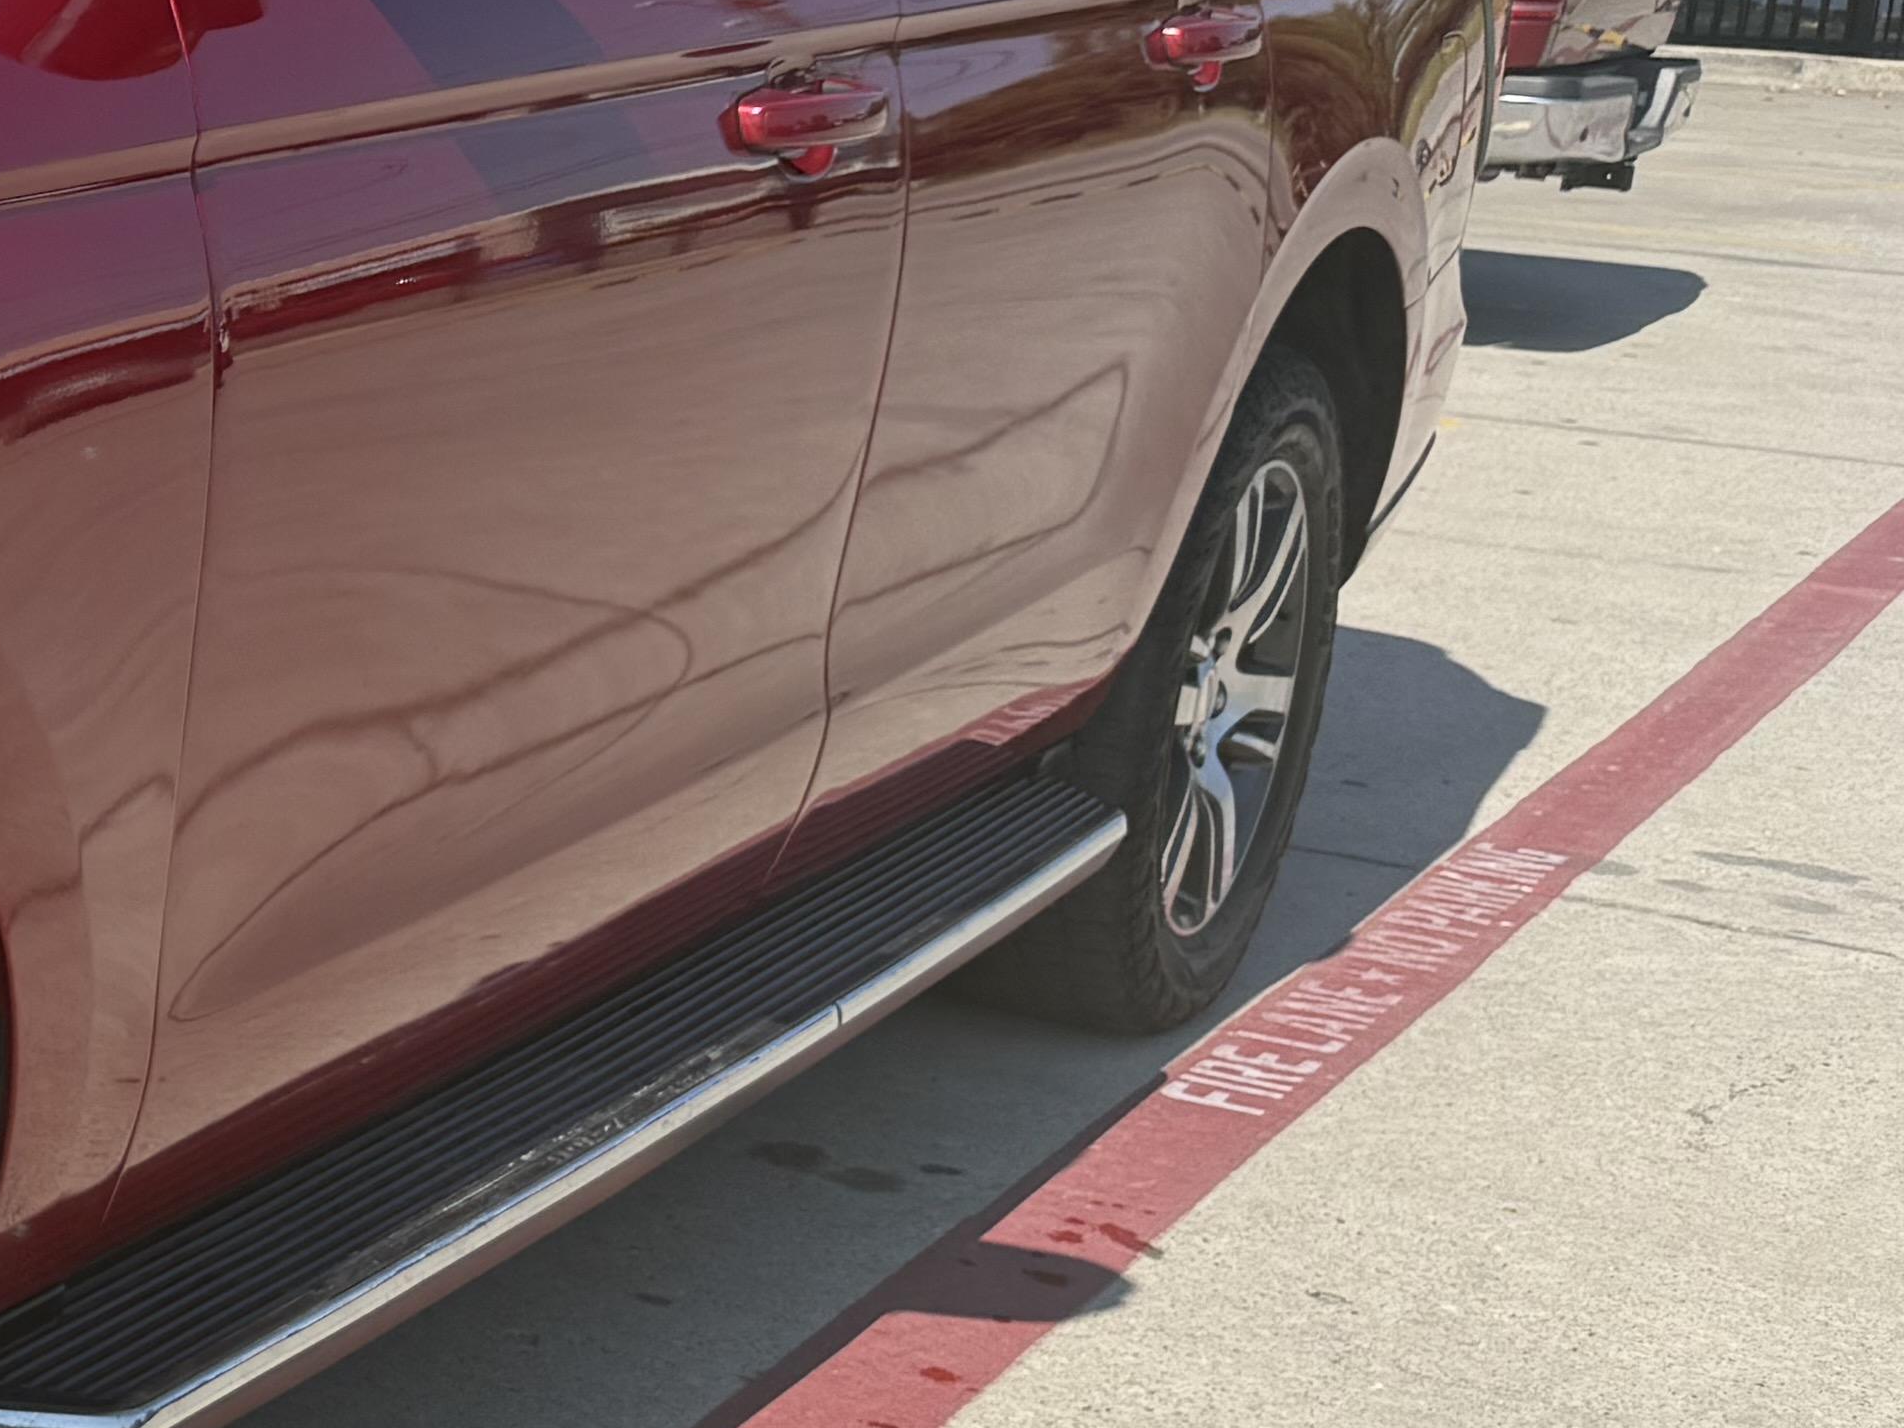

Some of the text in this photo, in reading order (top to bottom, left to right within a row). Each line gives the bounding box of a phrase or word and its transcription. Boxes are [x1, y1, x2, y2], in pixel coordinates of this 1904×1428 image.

[1160, 842, 1570, 1117] FIRE LANE NO PARKING
